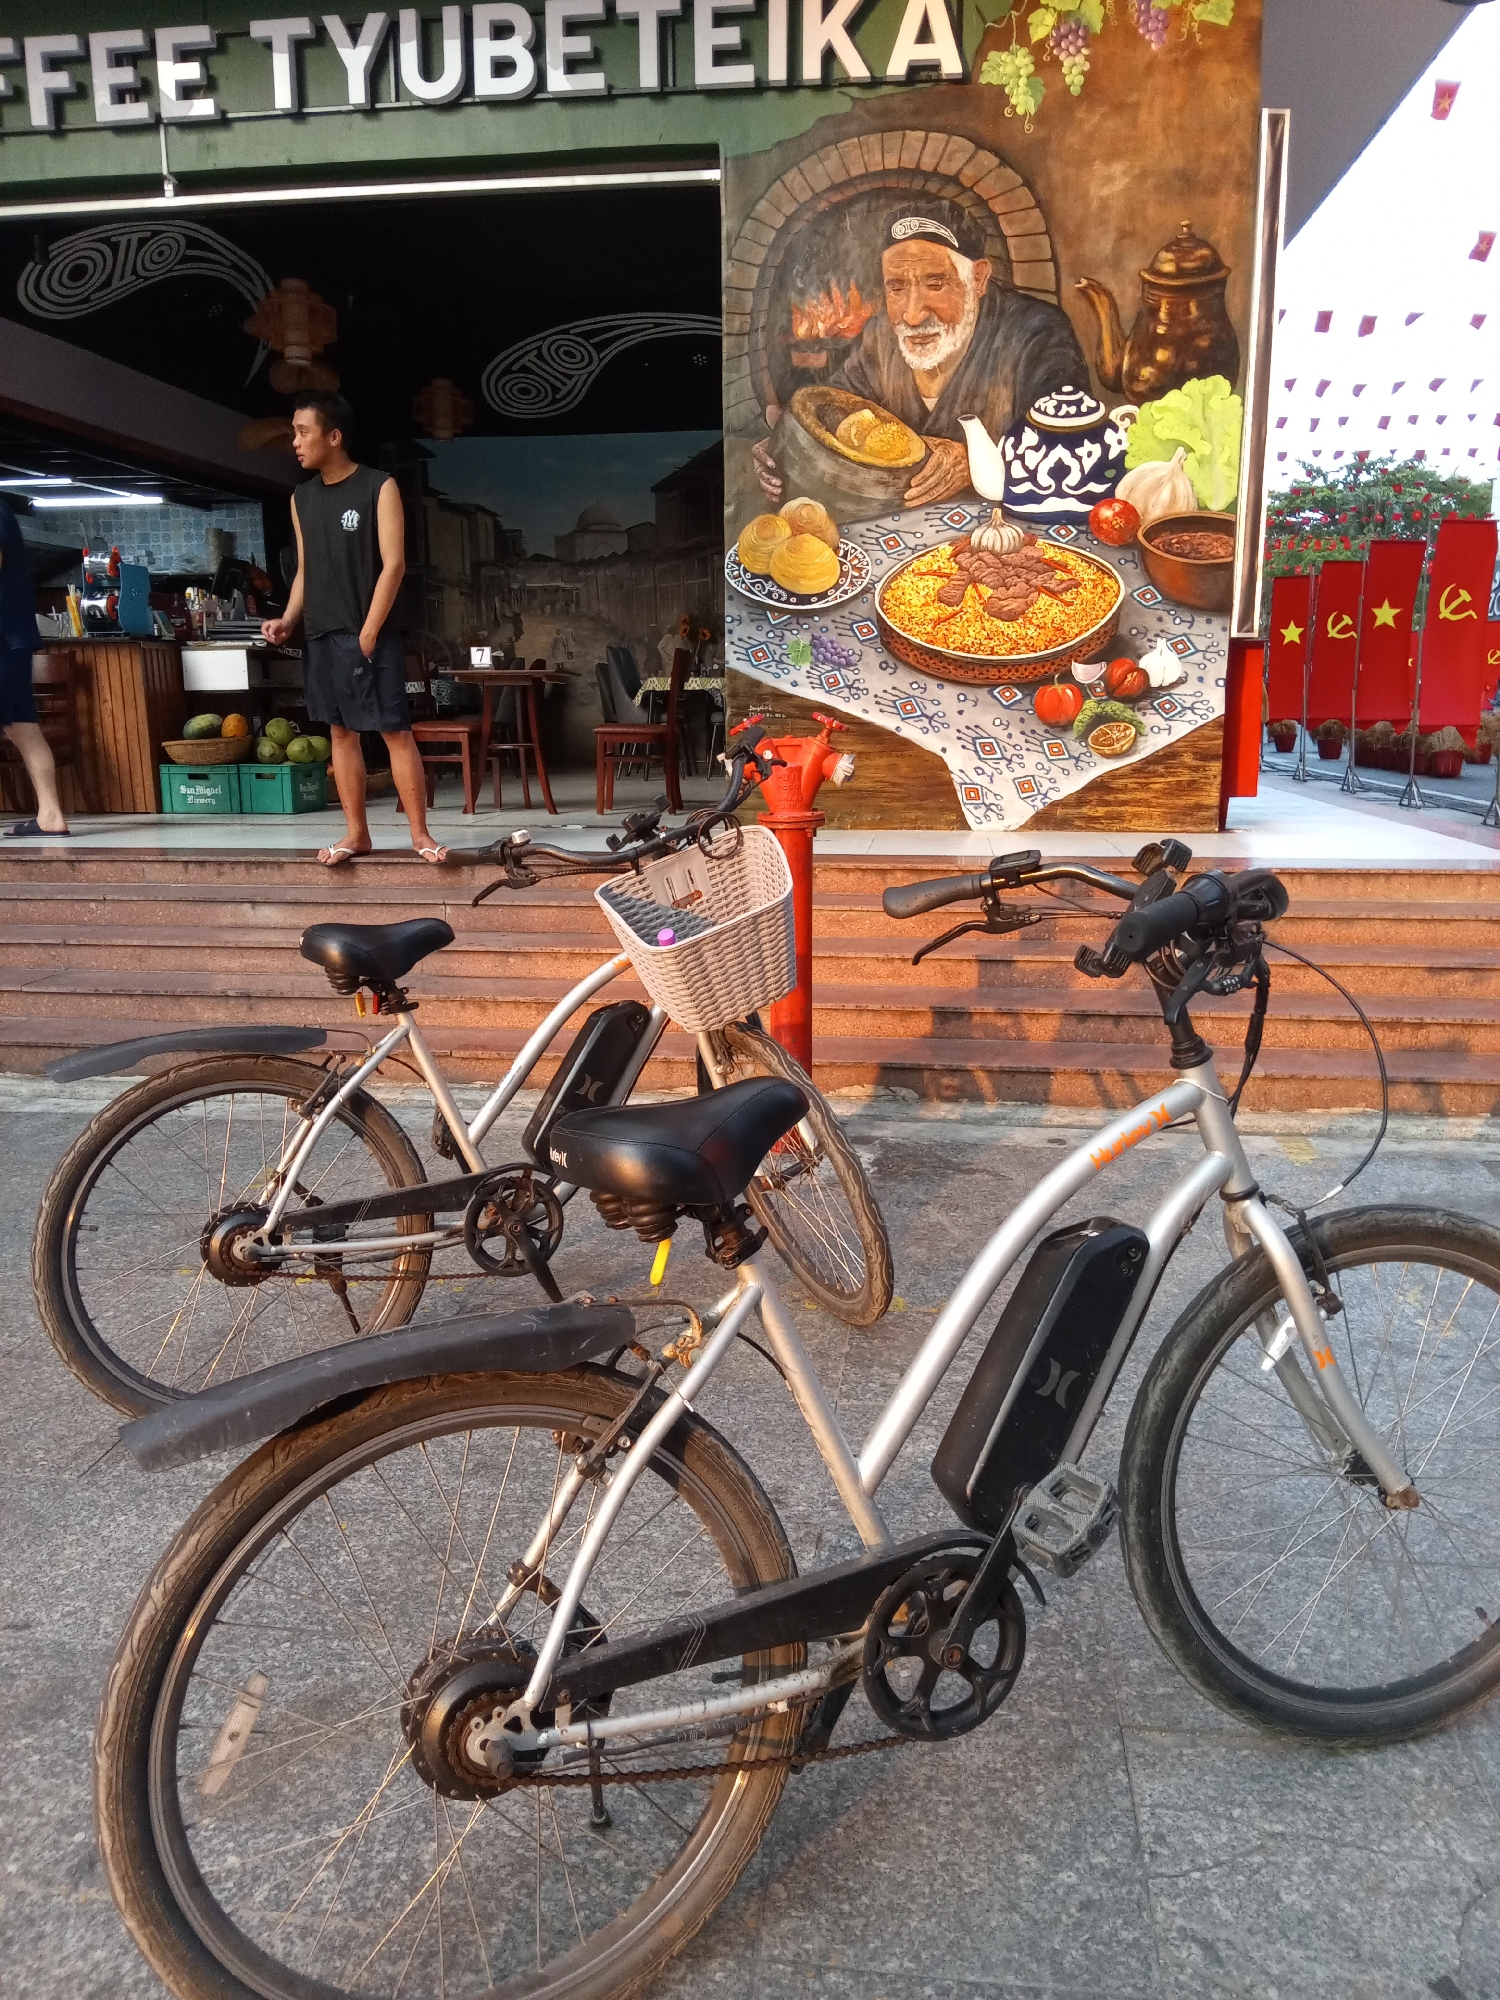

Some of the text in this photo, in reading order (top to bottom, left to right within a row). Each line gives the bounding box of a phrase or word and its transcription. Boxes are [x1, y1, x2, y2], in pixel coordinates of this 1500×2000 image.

[0, 0, 963, 129] FEE TYUBETEIKA
[475, 648, 485, 663] 7
[179, 784, 222, 797] San Miguel
[186, 794, 216, 805] Brewery
